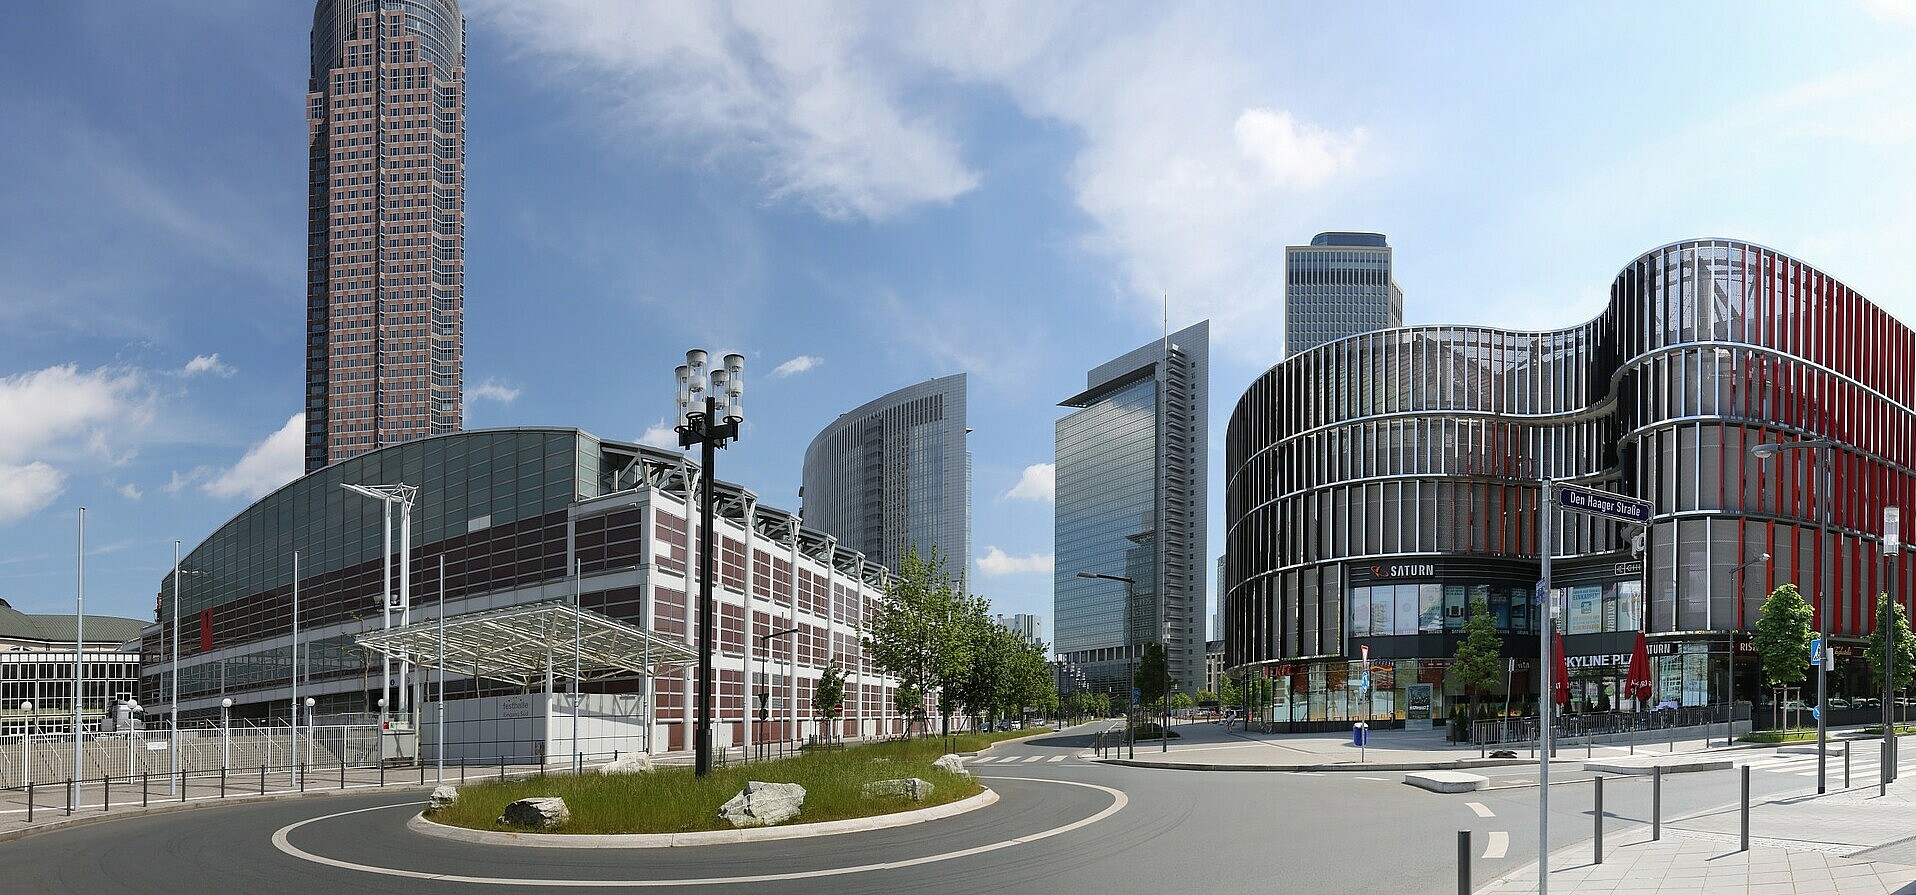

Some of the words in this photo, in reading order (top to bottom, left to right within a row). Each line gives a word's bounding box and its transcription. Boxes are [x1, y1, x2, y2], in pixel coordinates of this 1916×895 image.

[1570, 491, 1585, 505] Den
[1587, 495, 1614, 512] Haager
[1616, 501, 1640, 516] Straße
[1390, 564, 1434, 576] SATURN
[205, 610, 209, 629] 1
[1646, 643, 1670, 655] ATURN
[1613, 653, 1633, 665] PLA
